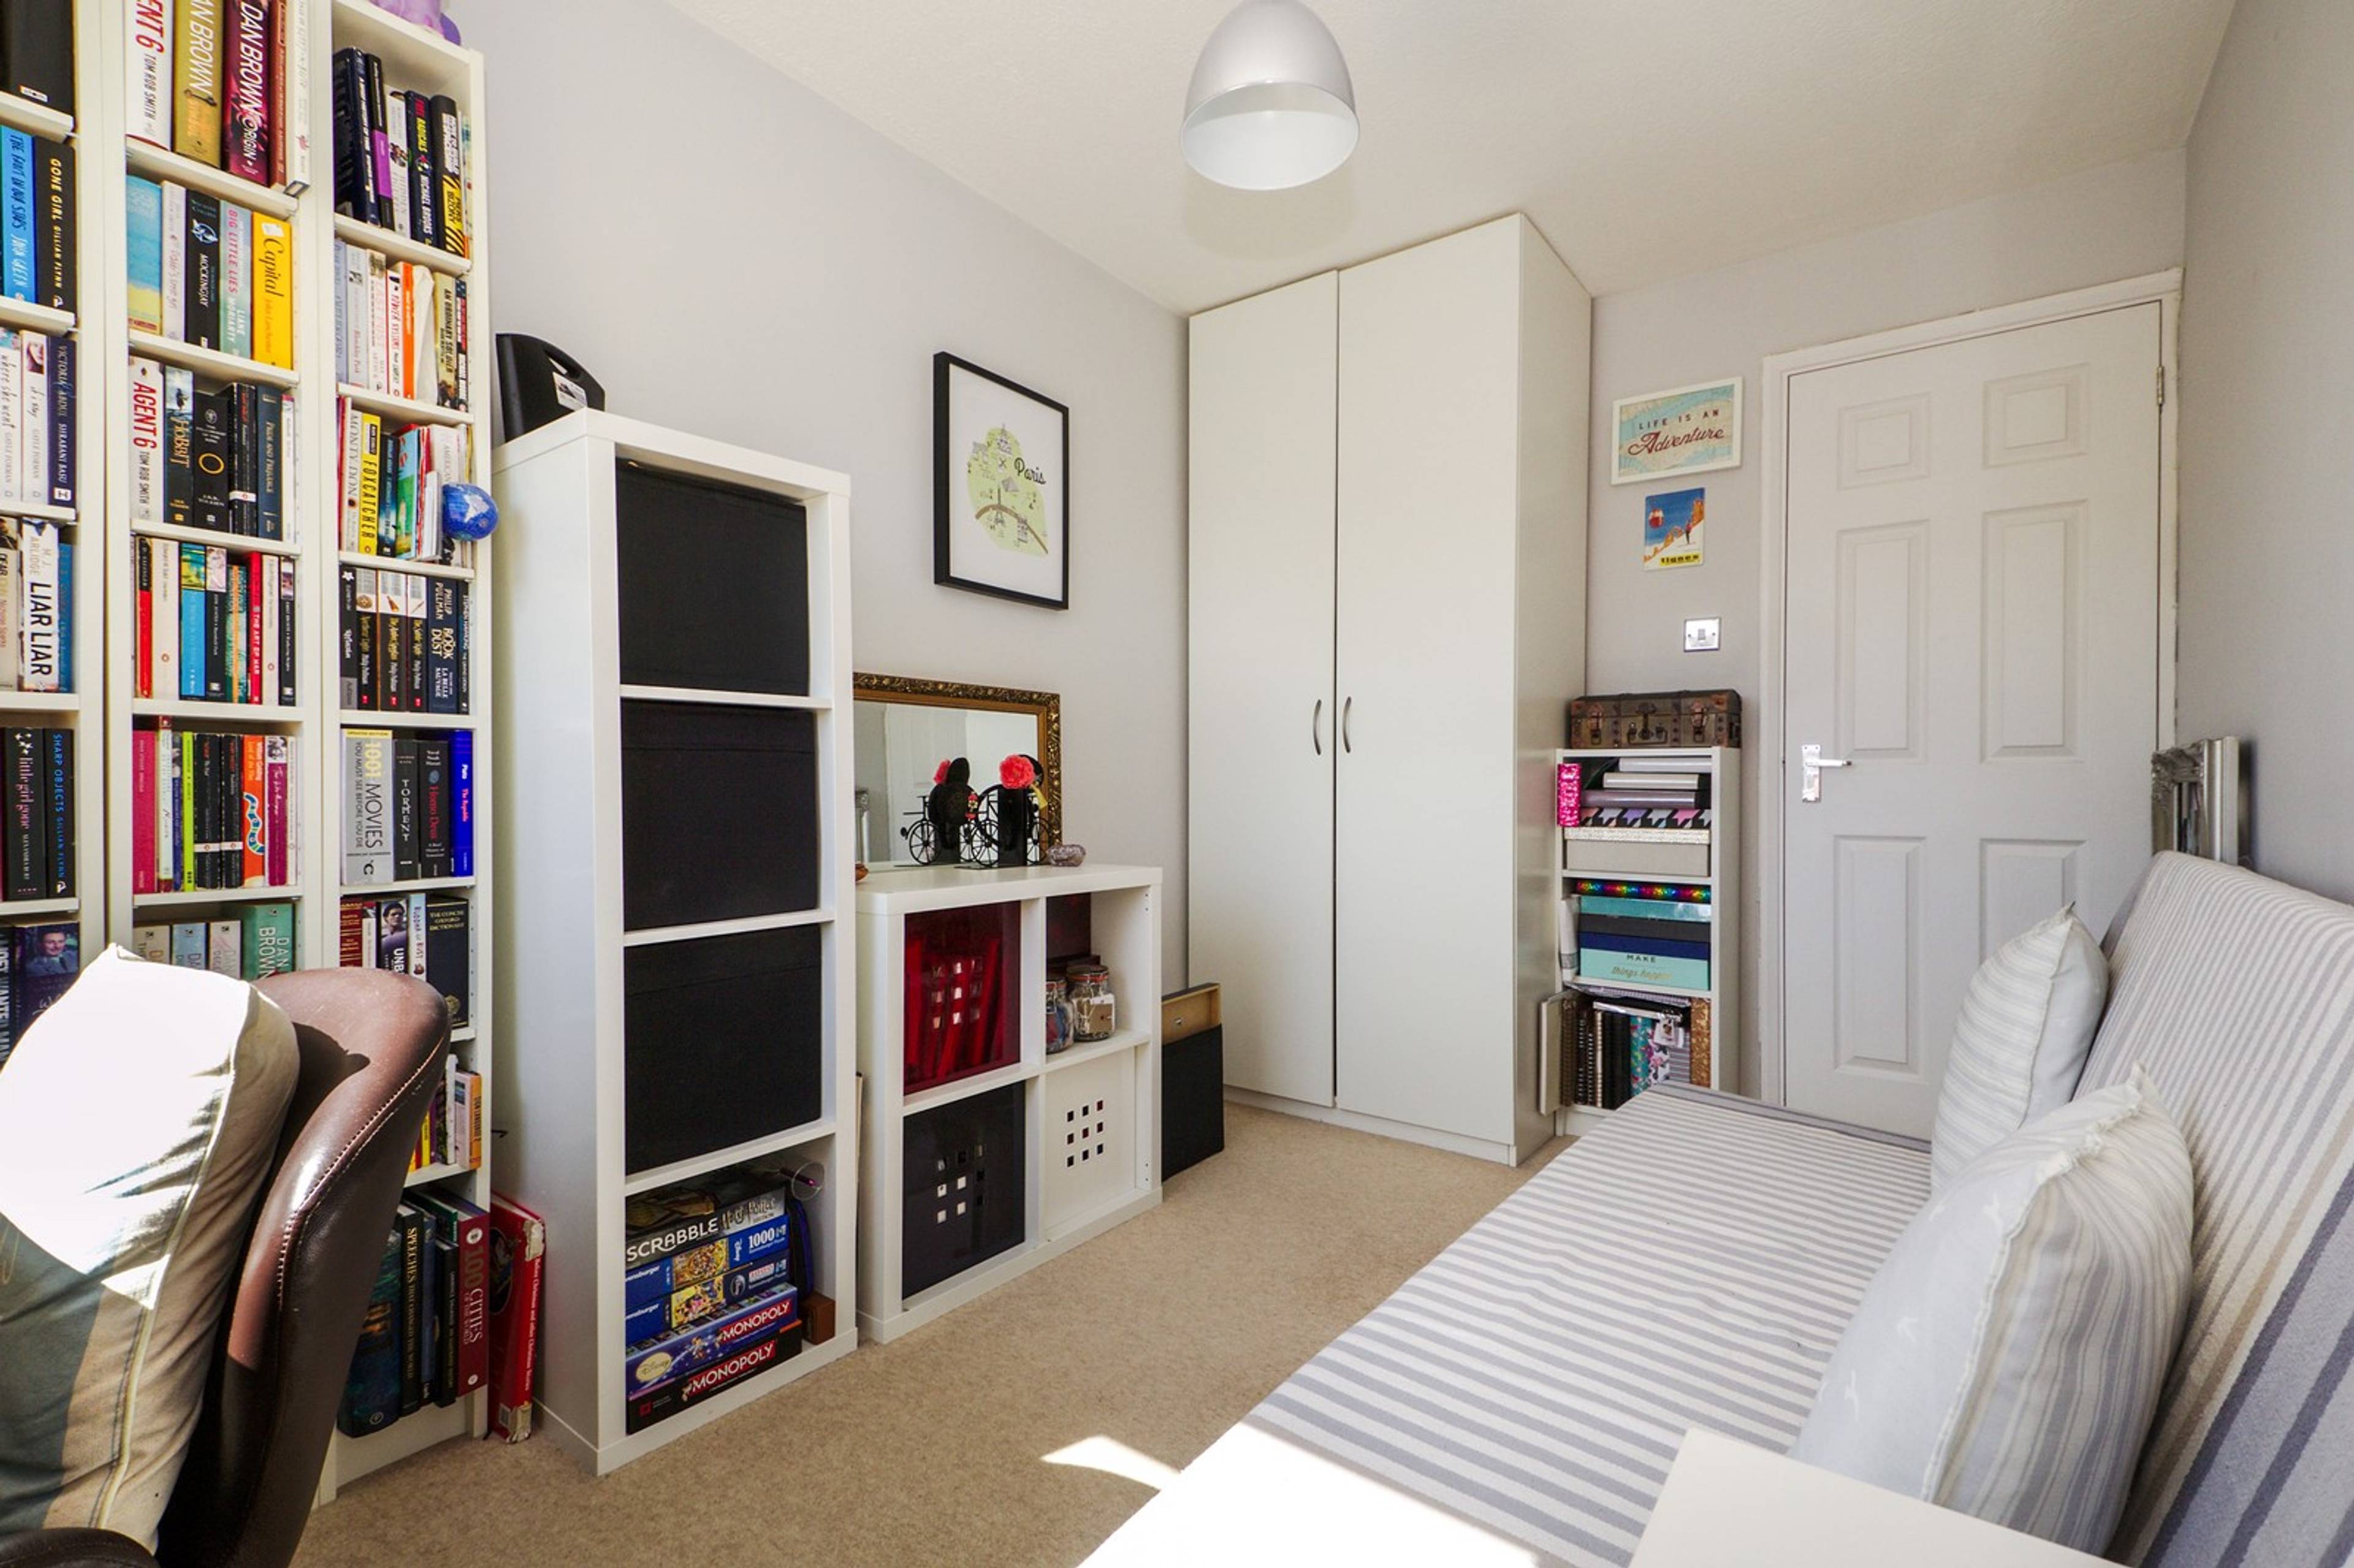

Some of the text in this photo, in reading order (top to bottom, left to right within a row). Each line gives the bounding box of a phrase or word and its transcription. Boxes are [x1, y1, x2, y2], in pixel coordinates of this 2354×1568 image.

[135, 35, 164, 53] 6
[144, 53, 156, 73] TOM
[189, 20, 215, 94] BROWN
[240, 2, 264, 114] DAN BROWN
[144, 93, 157, 121] SMITH
[416, 118, 429, 153] RADICALS
[50, 158, 63, 221] GONE GIRL
[419, 173, 433, 235] MICHAEL BROOKS
[53, 225, 63, 288] GILLIAN FLYNN
[228, 210, 238, 294] BIG LITTLE LIES
[259, 238, 285, 298] Capital
[444, 289, 454, 373] AN ORDINARY SOLDIER
[133, 382, 158, 448] AGENT 6
[1639, 409, 1720, 430] LIFE IS AN
[139, 451, 151, 466] TOM
[170, 417, 190, 468] HOBBIT
[347, 414, 360, 496] MONTY DON
[1628, 427, 1726, 455] Adventure
[1014, 457, 1046, 485] Paris
[139, 482, 151, 504] SMITH
[361, 460, 378, 539] FOXCATCHER
[251, 614, 260, 628] THE
[435, 582, 445, 620] PULLMAN
[443, 588, 454, 615] PHILIP
[29, 581, 53, 676] LIAR LIAR
[430, 628, 443, 657] DUST
[441, 628, 455, 661] BOOK
[52, 734, 64, 812] SHARP OBJECTS
[15, 758, 34, 830] little girl gone
[364, 741, 383, 849] 1001 MOVIES
[400, 778, 411, 842] TORMENT
[429, 786, 439, 815] Homo
[430, 816, 439, 842] Deus
[257, 926, 276, 979] BROWN
[276, 937, 291, 968] DAN
[1626, 954, 1656, 964] MAKE
[1611, 966, 1640, 982] things
[406, 1227, 417, 1282] SPEECHES
[627, 1218, 718, 1262] SCRABBLE
[748, 1227, 775, 1249] 1000
[464, 1247, 484, 1342] 100 CITIES
[530, 1278, 539, 1309] Christmas
[723, 1300, 790, 1341] MONOPOLY
[525, 1338, 535, 1369] Christmas
[692, 1342, 774, 1393] MONOPOLY
